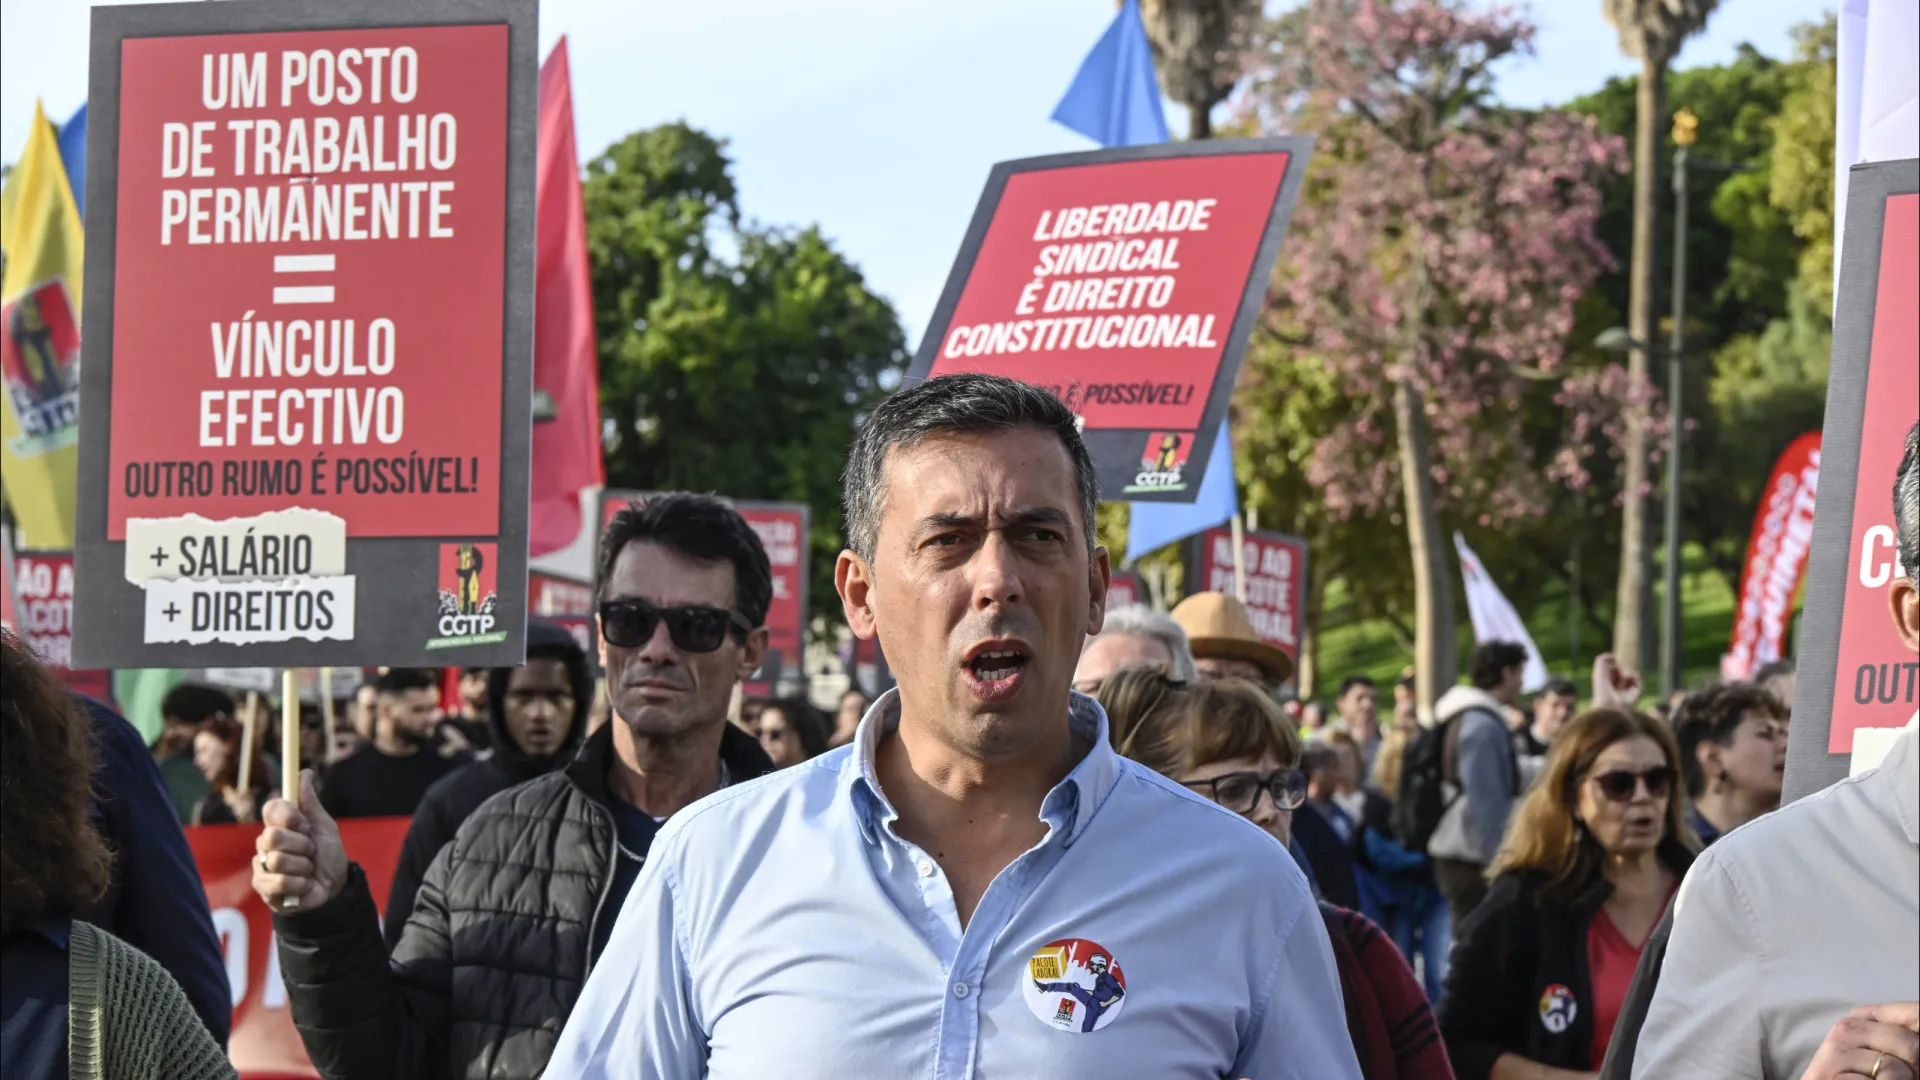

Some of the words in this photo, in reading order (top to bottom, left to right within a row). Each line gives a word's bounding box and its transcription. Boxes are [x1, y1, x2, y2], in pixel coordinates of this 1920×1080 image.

[203, 52, 267, 110] UM
[281, 46, 418, 106] POSTO
[162, 121, 216, 178] DE
[228, 113, 457, 176] TRABALHO
[161, 181, 455, 245] PERMANENTE
[1033, 199, 1217, 241] LIBERDADE
[1033, 238, 1180, 277] SINDICAL
[1015, 277, 1044, 315] É
[1042, 275, 1175, 313] DIREITO
[211, 310, 396, 378] VÍNCULO
[944, 314, 1217, 359] CONSTITUCIONAL
[1083, 378, 1195, 405] POSSÍVEL!
[199, 386, 404, 447] EFECTIVO
[125, 461, 212, 498] OUTRO
[222, 459, 302, 496] RUMO
[311, 452, 328, 495] É
[336, 451, 479, 494] POSSÍVEL!
[1134, 471, 1182, 487] CGTP
[179, 527, 312, 576] SALÁRIO
[192, 590, 334, 632] DIREITOS
[438, 614, 495, 636] CGTP
[1032, 957, 1055, 967] PACOTE
[1033, 968, 1059, 978] LABORAL
